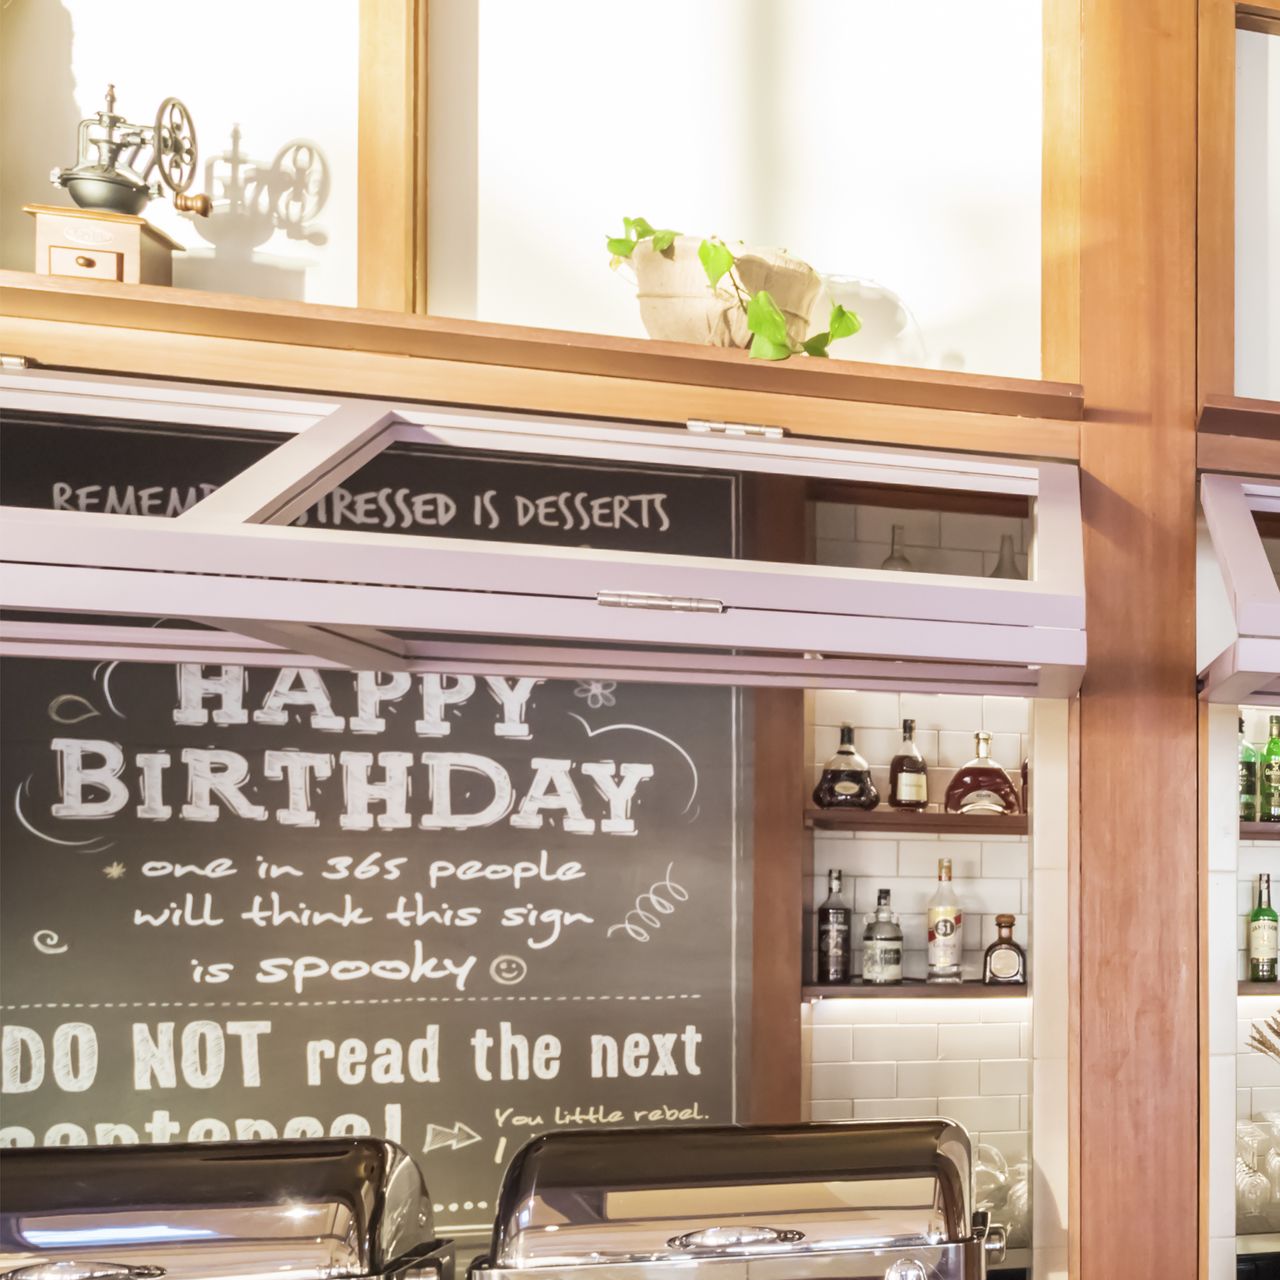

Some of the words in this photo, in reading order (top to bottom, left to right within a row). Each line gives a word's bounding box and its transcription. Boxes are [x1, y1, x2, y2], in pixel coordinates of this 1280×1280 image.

[473, 492, 500, 528] IS
[516, 494, 671, 531] DESSERTS
[172, 663, 546, 740] HAPPY
[49, 738, 654, 836] BIRTHDAY
[142, 857, 237, 879] one
[257, 856, 304, 880] in
[321, 854, 408, 881] 365
[428, 850, 587, 887] people
[134, 896, 223, 928] will
[241, 893, 372, 926] think
[386, 893, 480, 926] this
[501, 907, 594, 949] sign
[191, 956, 234, 984] is
[256, 940, 478, 994] spooky
[0, 1022, 98, 1094] DO
[132, 1020, 272, 1090] NOT
[306, 1024, 441, 1086] read
[470, 1022, 561, 1080] the
[590, 1024, 703, 1077] next
[494, 1108, 544, 1127] You
[555, 1104, 625, 1124] little
[633, 1102, 710, 1122] rebel.
